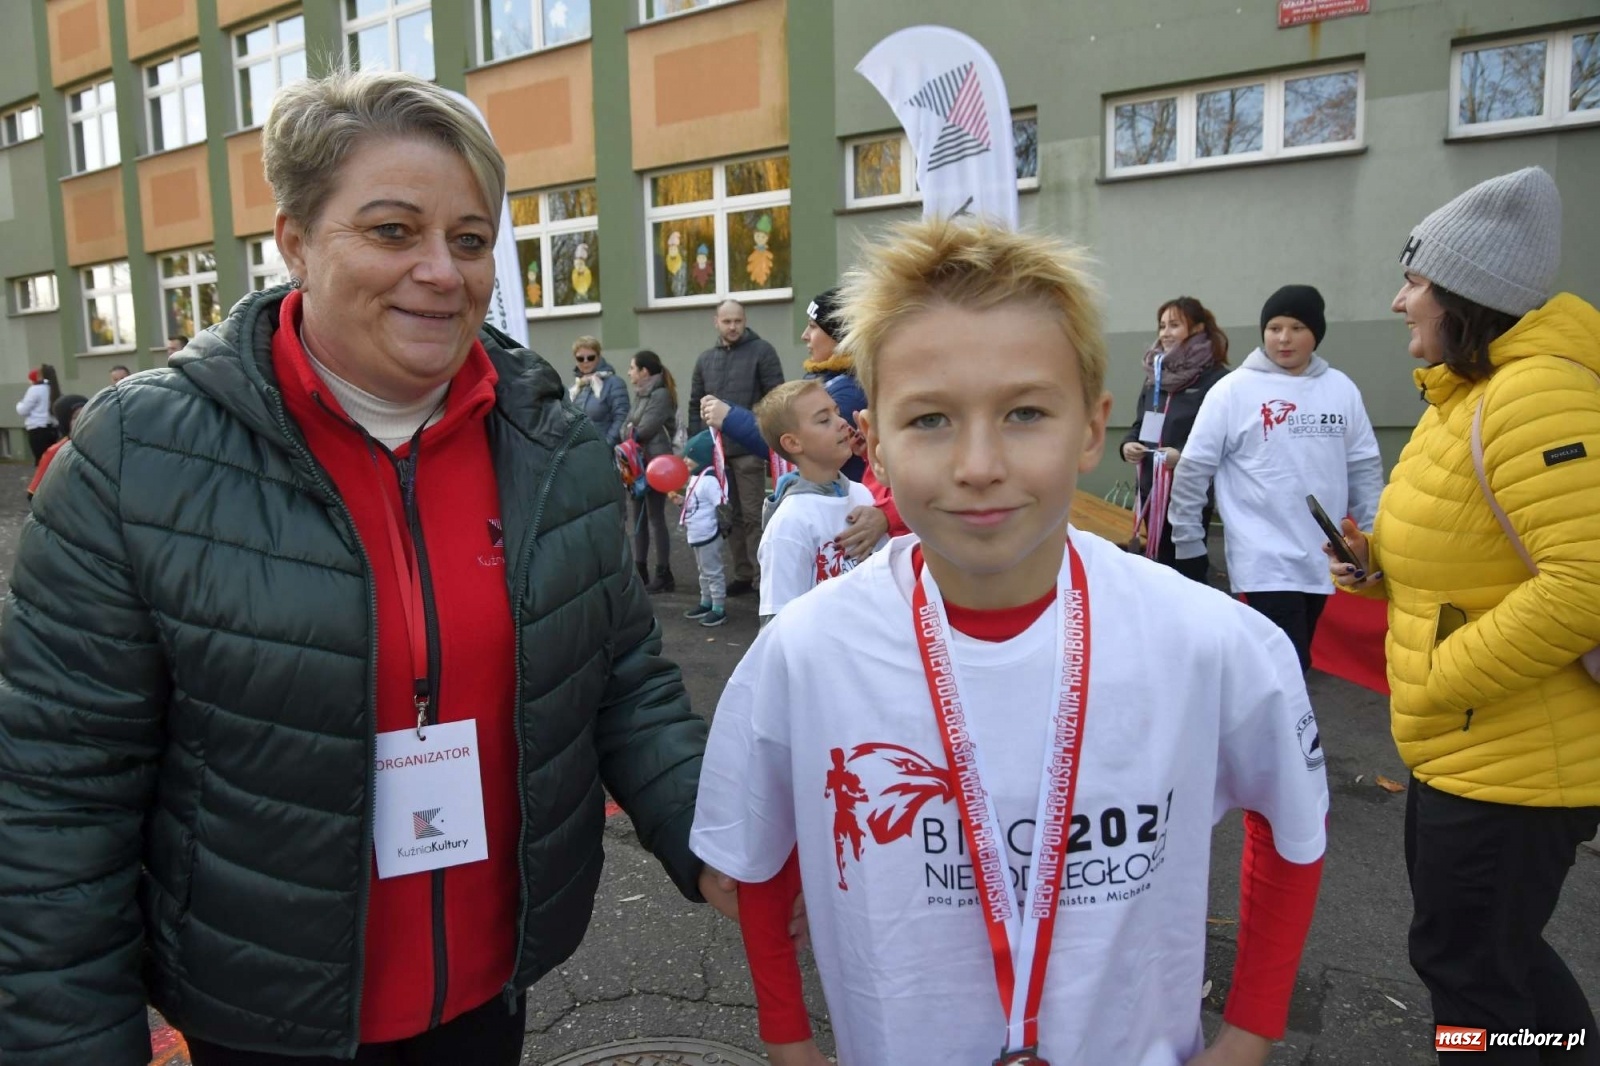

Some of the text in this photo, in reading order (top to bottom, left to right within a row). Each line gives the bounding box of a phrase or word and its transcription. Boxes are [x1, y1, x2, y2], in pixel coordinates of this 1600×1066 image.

[919, 602, 943, 638] BIEG
[926, 637, 976, 767] NIEPODLEGŁOŚCI
[376, 746, 471, 771] ORGANIZATOR
[1031, 588, 1084, 919] BIEG NIEPODLEGŁOŚCI KUŹNIA RACIBORSKA
[958, 768, 989, 826] KUŹNIA
[923, 817, 1036, 856] BIG
[973, 827, 1012, 923] RACIBORSKA
[928, 896, 952, 906] pod
